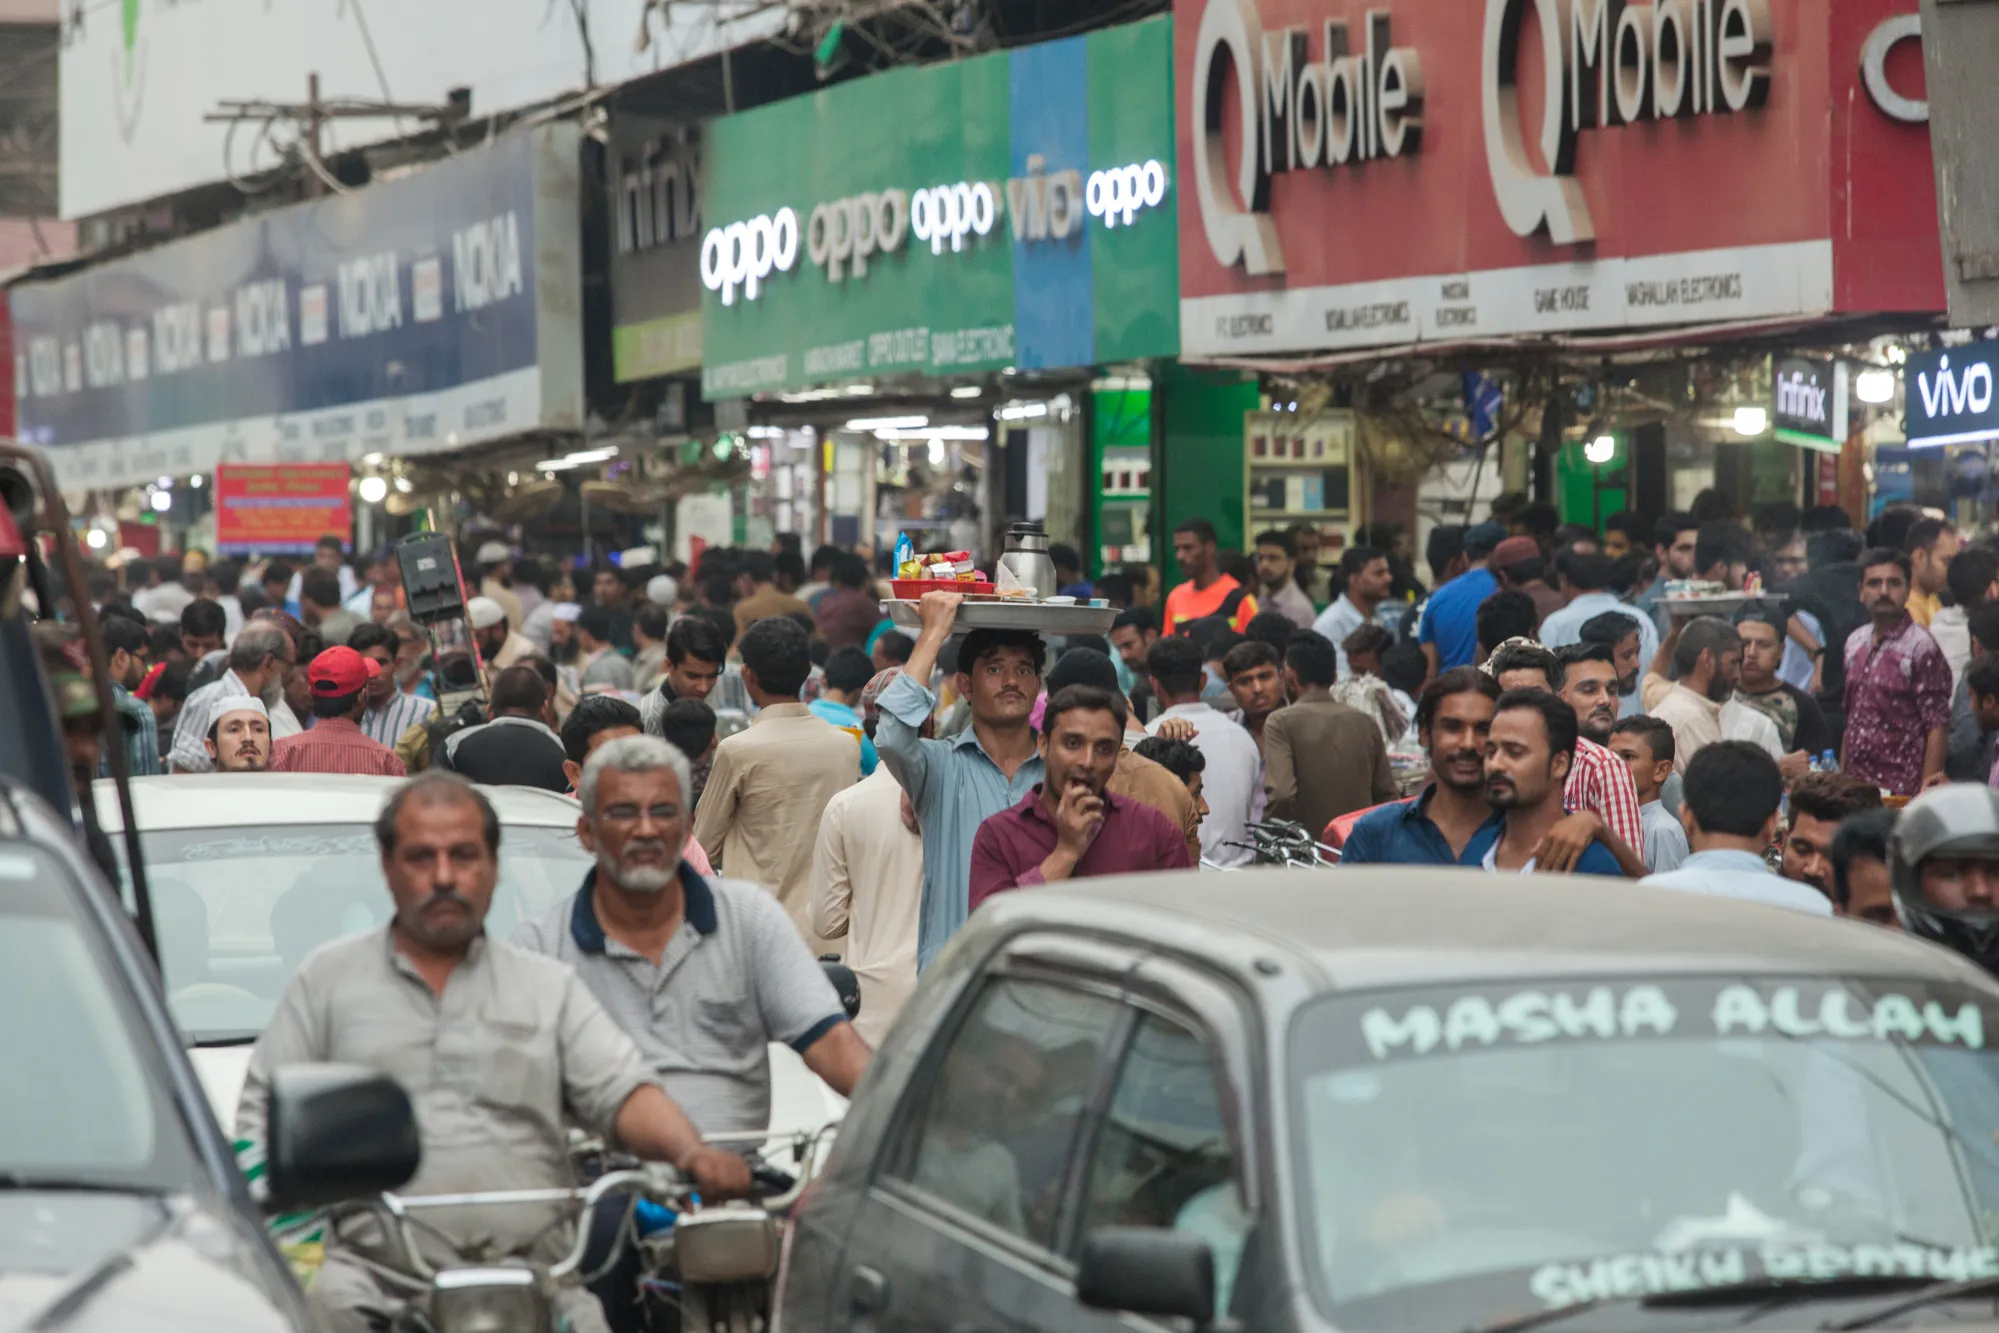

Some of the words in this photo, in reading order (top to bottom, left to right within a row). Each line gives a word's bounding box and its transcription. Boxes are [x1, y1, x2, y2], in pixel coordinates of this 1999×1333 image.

[910, 181, 995, 255] oppo
[1006, 154, 1078, 241] vivo
[1086, 159, 1166, 229] oppo
[453, 210, 522, 313] NOKIA
[700, 207, 798, 307] oppo
[808, 188, 906, 283] oppo
[338, 253, 403, 340] NOKIA
[1777, 370, 1827, 422] Infinix
[1917, 353, 1993, 419] vivo
[1360, 984, 1677, 1060] MASHA
[1710, 984, 1984, 1050] ALLAH
